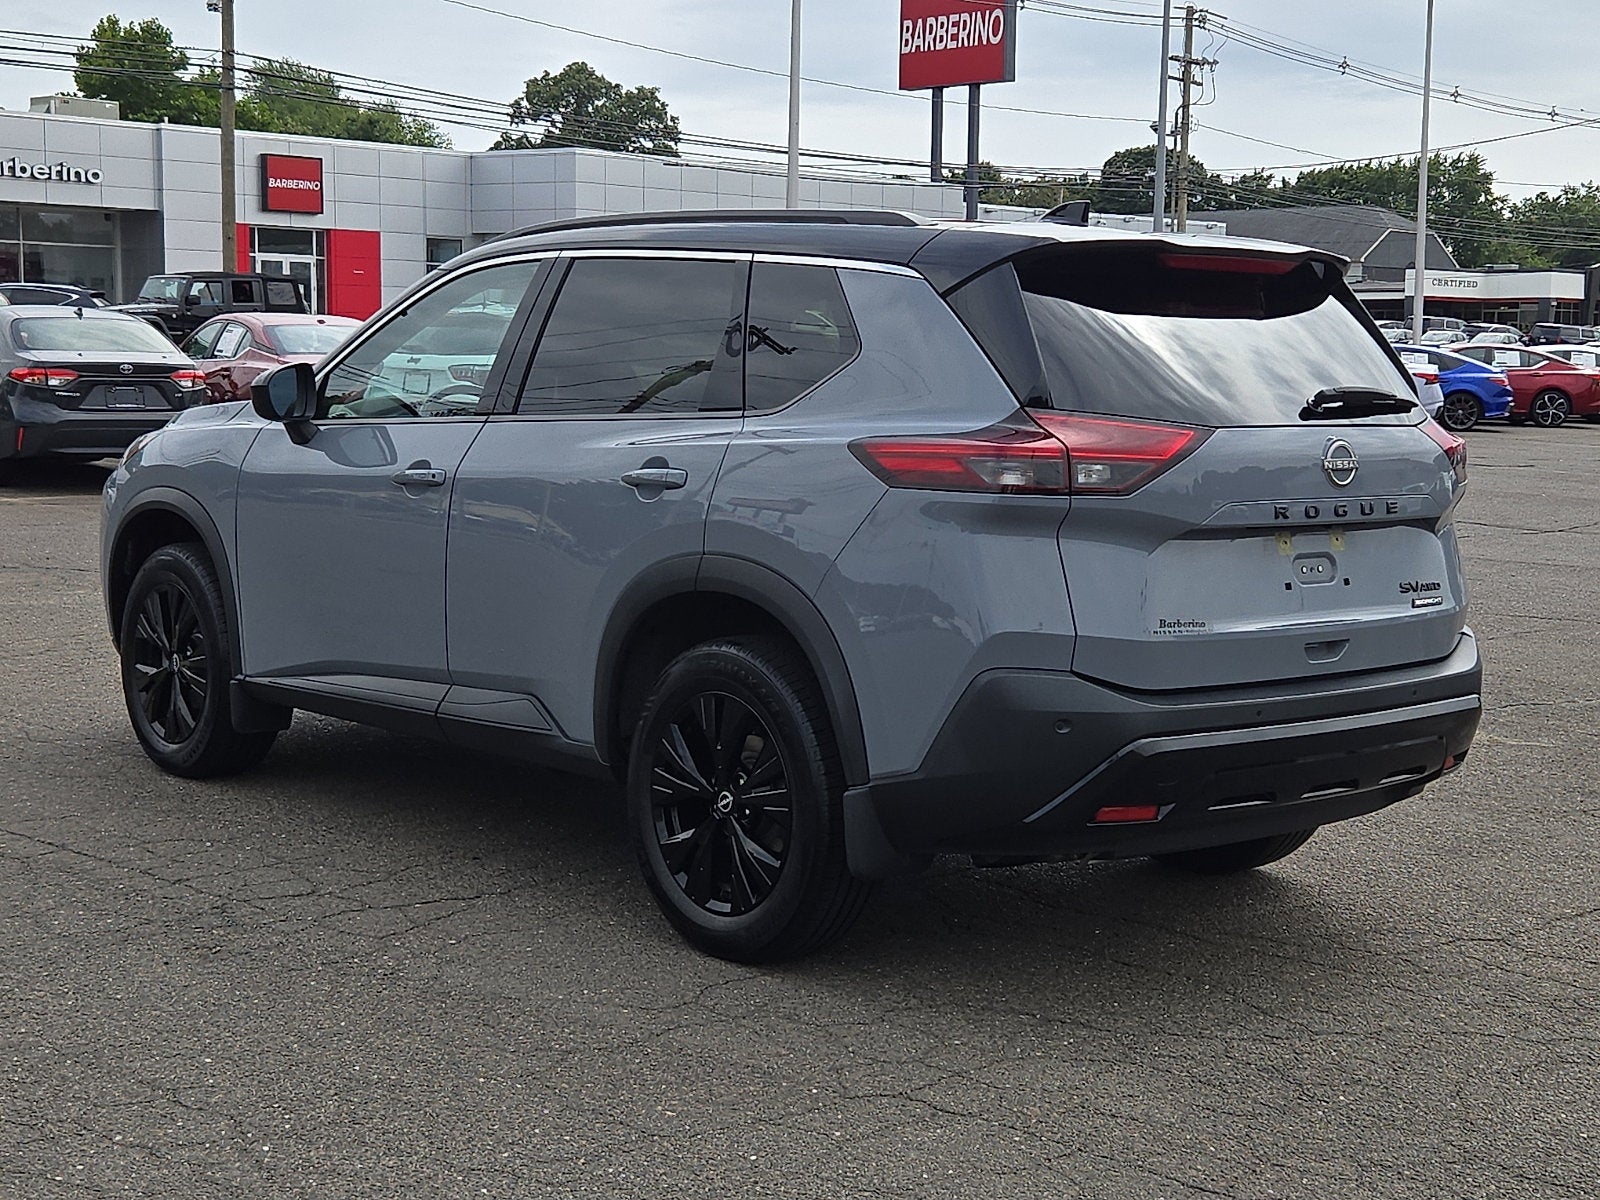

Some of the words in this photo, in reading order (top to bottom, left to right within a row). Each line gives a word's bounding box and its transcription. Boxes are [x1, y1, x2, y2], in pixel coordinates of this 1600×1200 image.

[901, 8, 1004, 54] BARBERINO
[0, 157, 104, 184] rberino
[268, 177, 321, 191] BARBERINO
[1431, 278, 1478, 288] CERTIFIED
[1324, 460, 1359, 470] NISSAN
[1273, 501, 1399, 520] ROGUE
[1159, 619, 1206, 629] Barberino
